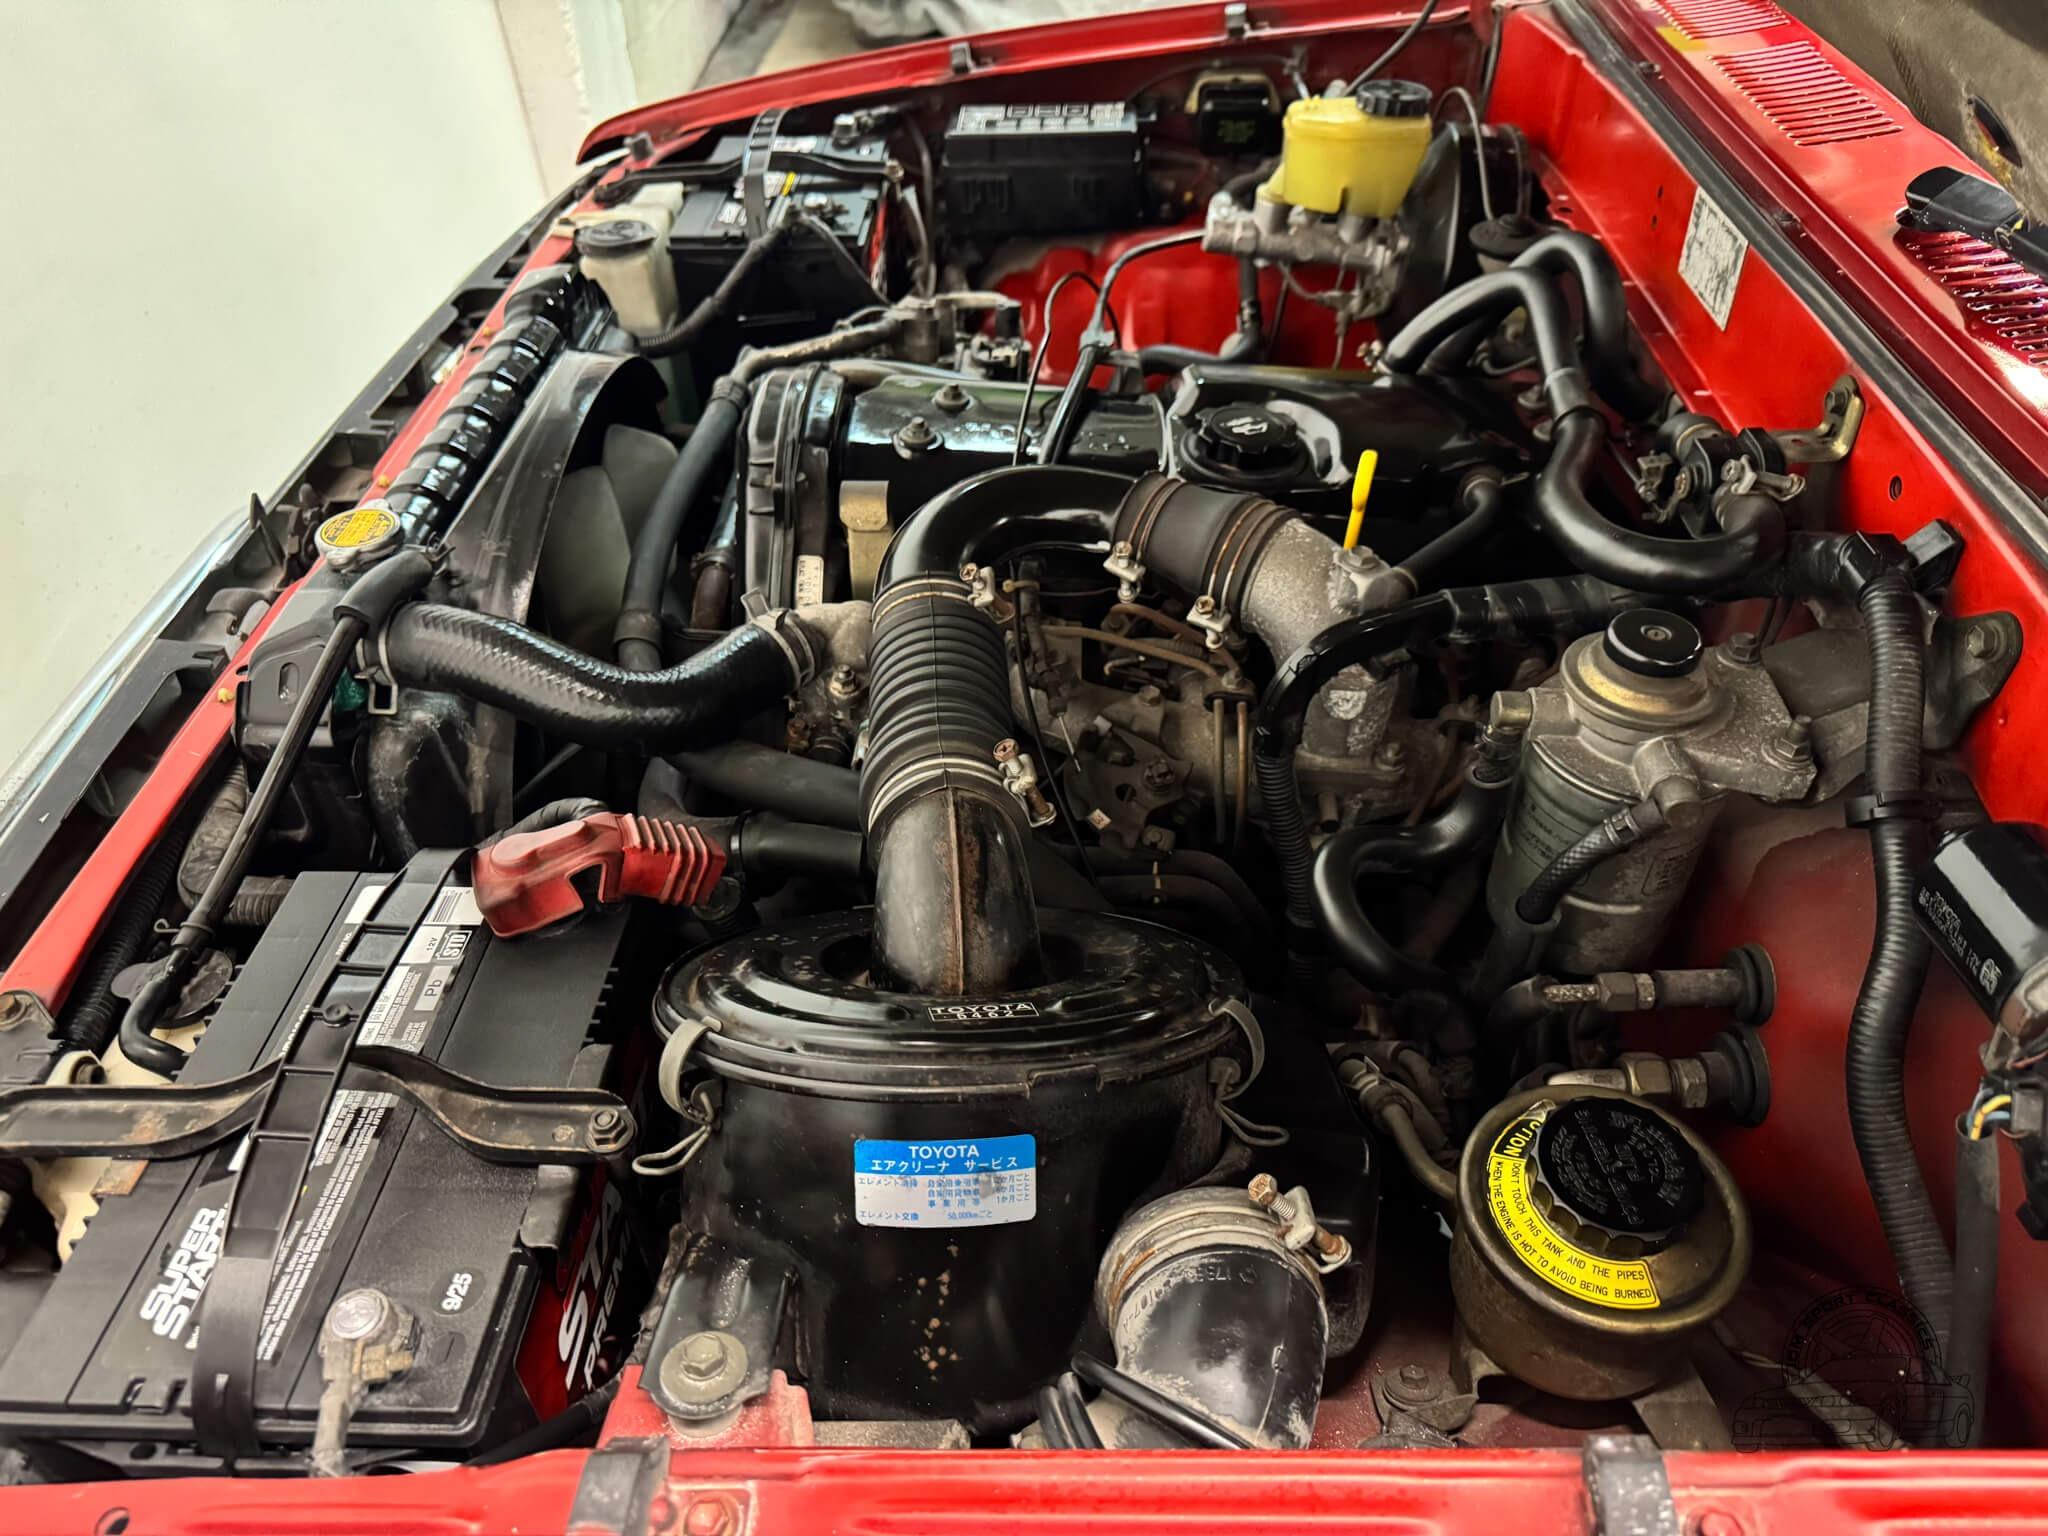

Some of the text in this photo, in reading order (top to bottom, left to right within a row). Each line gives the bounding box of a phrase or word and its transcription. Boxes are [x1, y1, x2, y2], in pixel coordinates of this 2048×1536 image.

[427, 936, 440, 952] 12V
[445, 932, 468, 958] STD
[424, 979, 443, 997] Pb
[931, 1003, 1033, 1014] TOYOTA
[1503, 1120, 1541, 1157] UTION
[871, 1156, 1018, 1173] エアクリーナ サービス
[908, 1145, 980, 1159] TOYOTA
[1493, 1161, 1651, 1299] WHEN THE ENGINE IS HOT TO AVOID BEING BURNED
[1512, 1163, 1645, 1281] DON'T TOUCH THIS TANK AND THE PIPES
[140, 1207, 218, 1320] SUPER
[441, 1272, 473, 1312] 9/25
